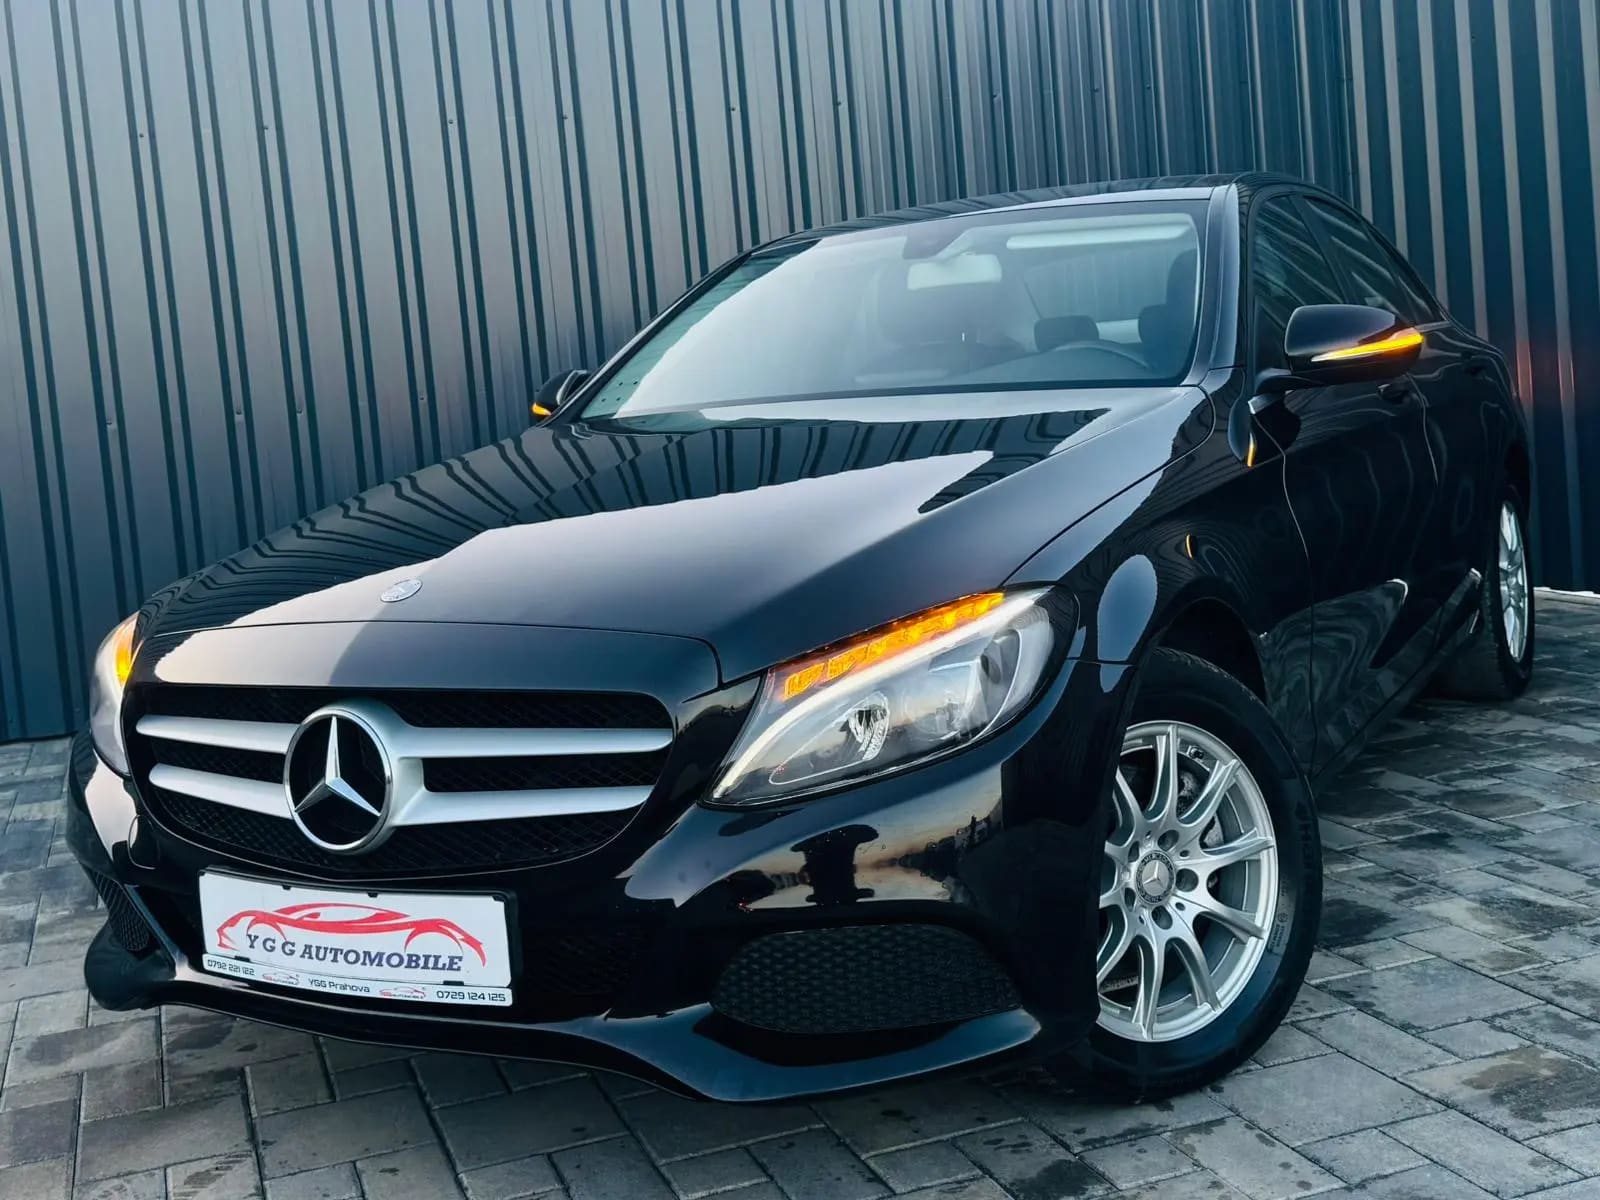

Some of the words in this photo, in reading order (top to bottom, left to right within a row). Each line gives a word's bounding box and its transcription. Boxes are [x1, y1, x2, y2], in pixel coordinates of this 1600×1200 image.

[247, 934, 259, 949] Y
[299, 943, 462, 972] AUTOMOBILE
[207, 959, 226, 970] 0792
[228, 963, 241, 973] 221
[241, 966, 255, 976] 122
[308, 978, 327, 988] YGG
[328, 981, 370, 993] Prahova
[436, 990, 465, 1000] 0729
[467, 991, 486, 1001] 124
[488, 992, 506, 1002] 125
